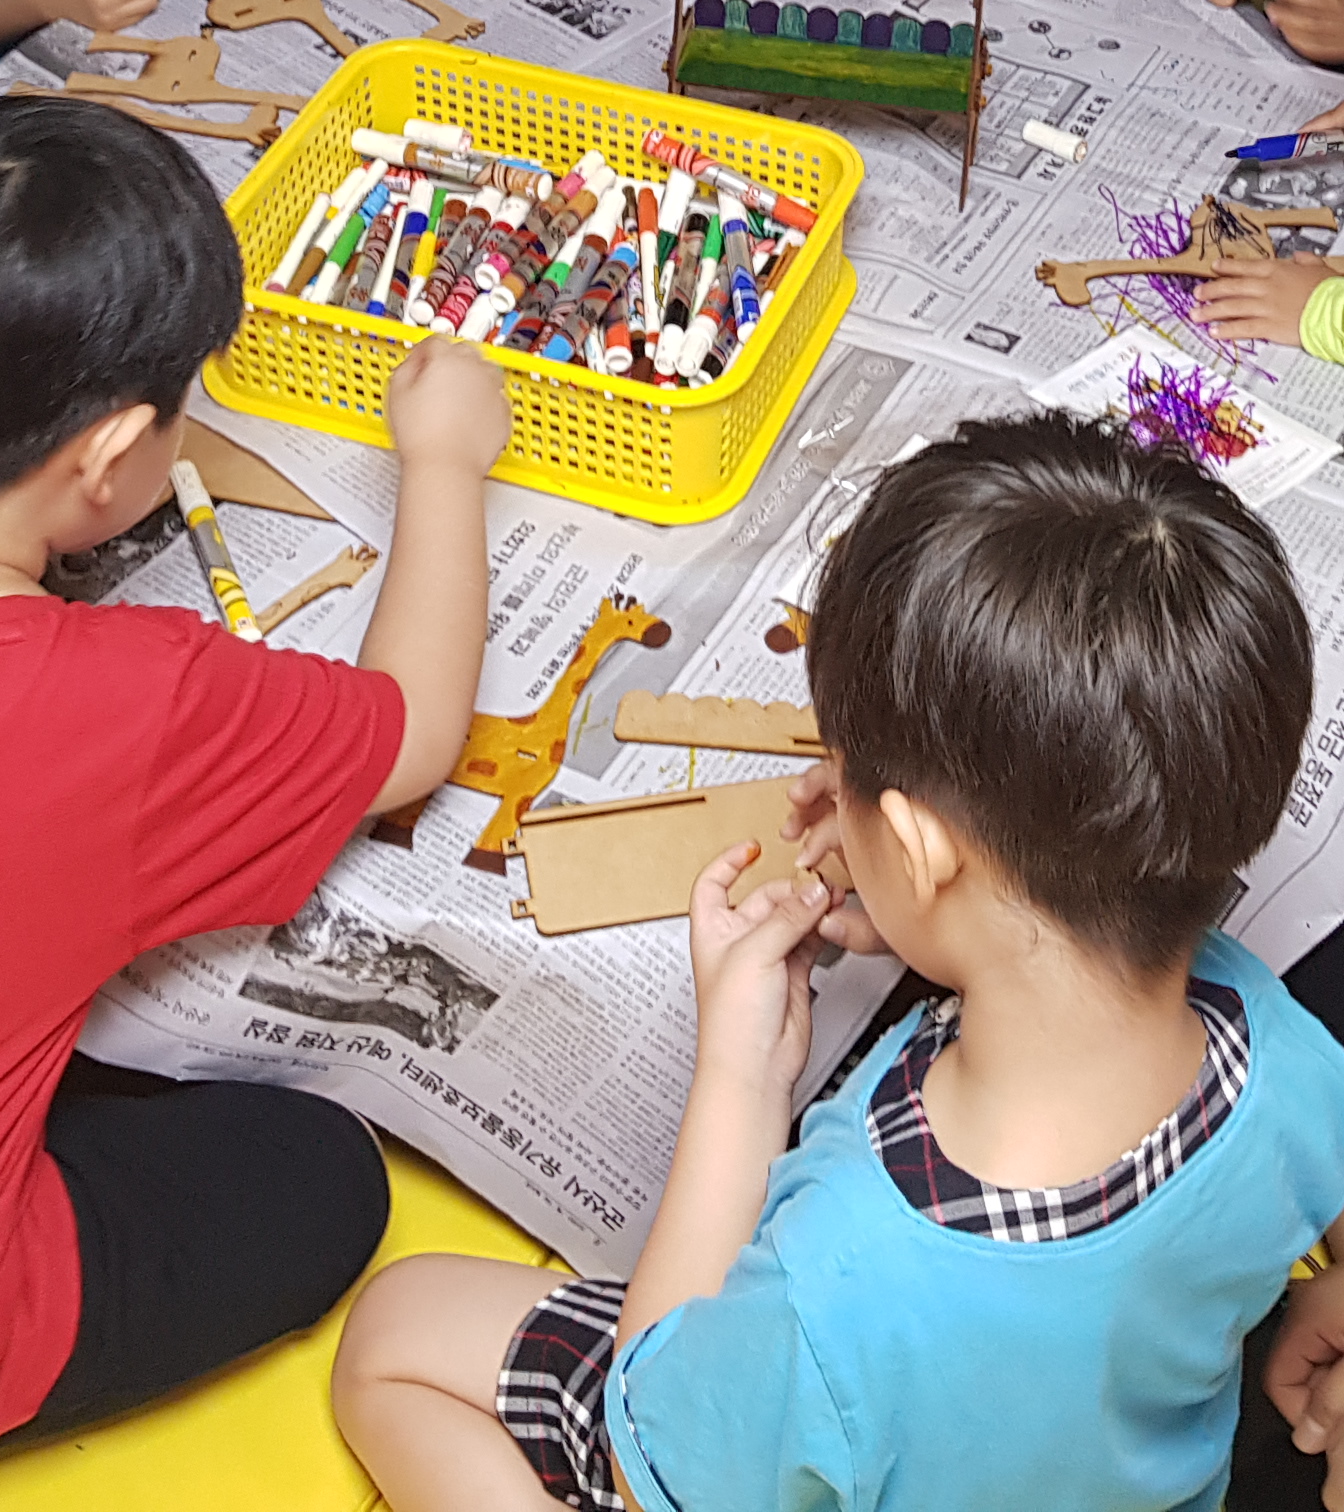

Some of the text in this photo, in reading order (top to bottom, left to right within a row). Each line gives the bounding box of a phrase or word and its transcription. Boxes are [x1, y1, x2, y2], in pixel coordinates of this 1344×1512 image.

[295, 1029, 345, 1052] 지원
[346, 1034, 393, 1061] 예산
[563, 1175, 627, 1233] 군산시
